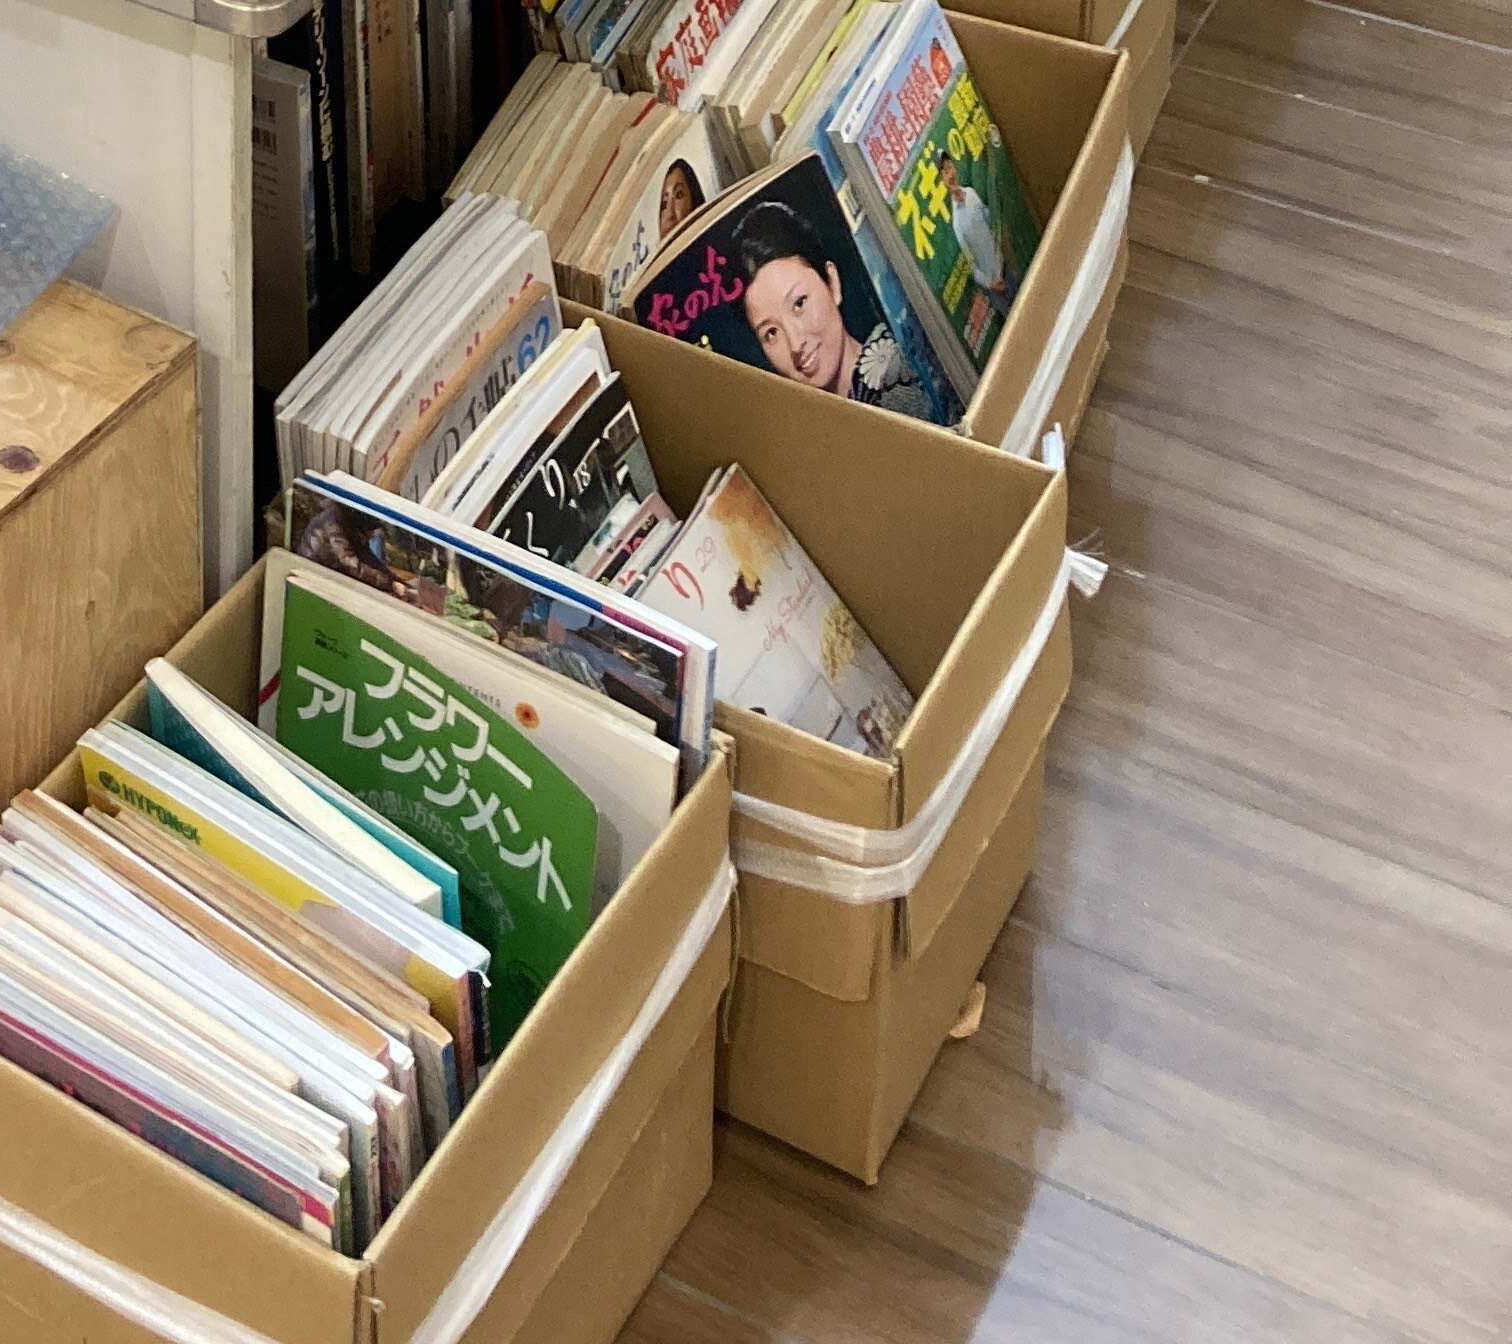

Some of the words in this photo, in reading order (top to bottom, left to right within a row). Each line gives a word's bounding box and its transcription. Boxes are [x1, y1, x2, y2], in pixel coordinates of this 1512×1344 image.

[646, 243, 745, 339] 家の光
[296, 665, 573, 912] アレンジメント
[360, 637, 534, 790] フラワー
